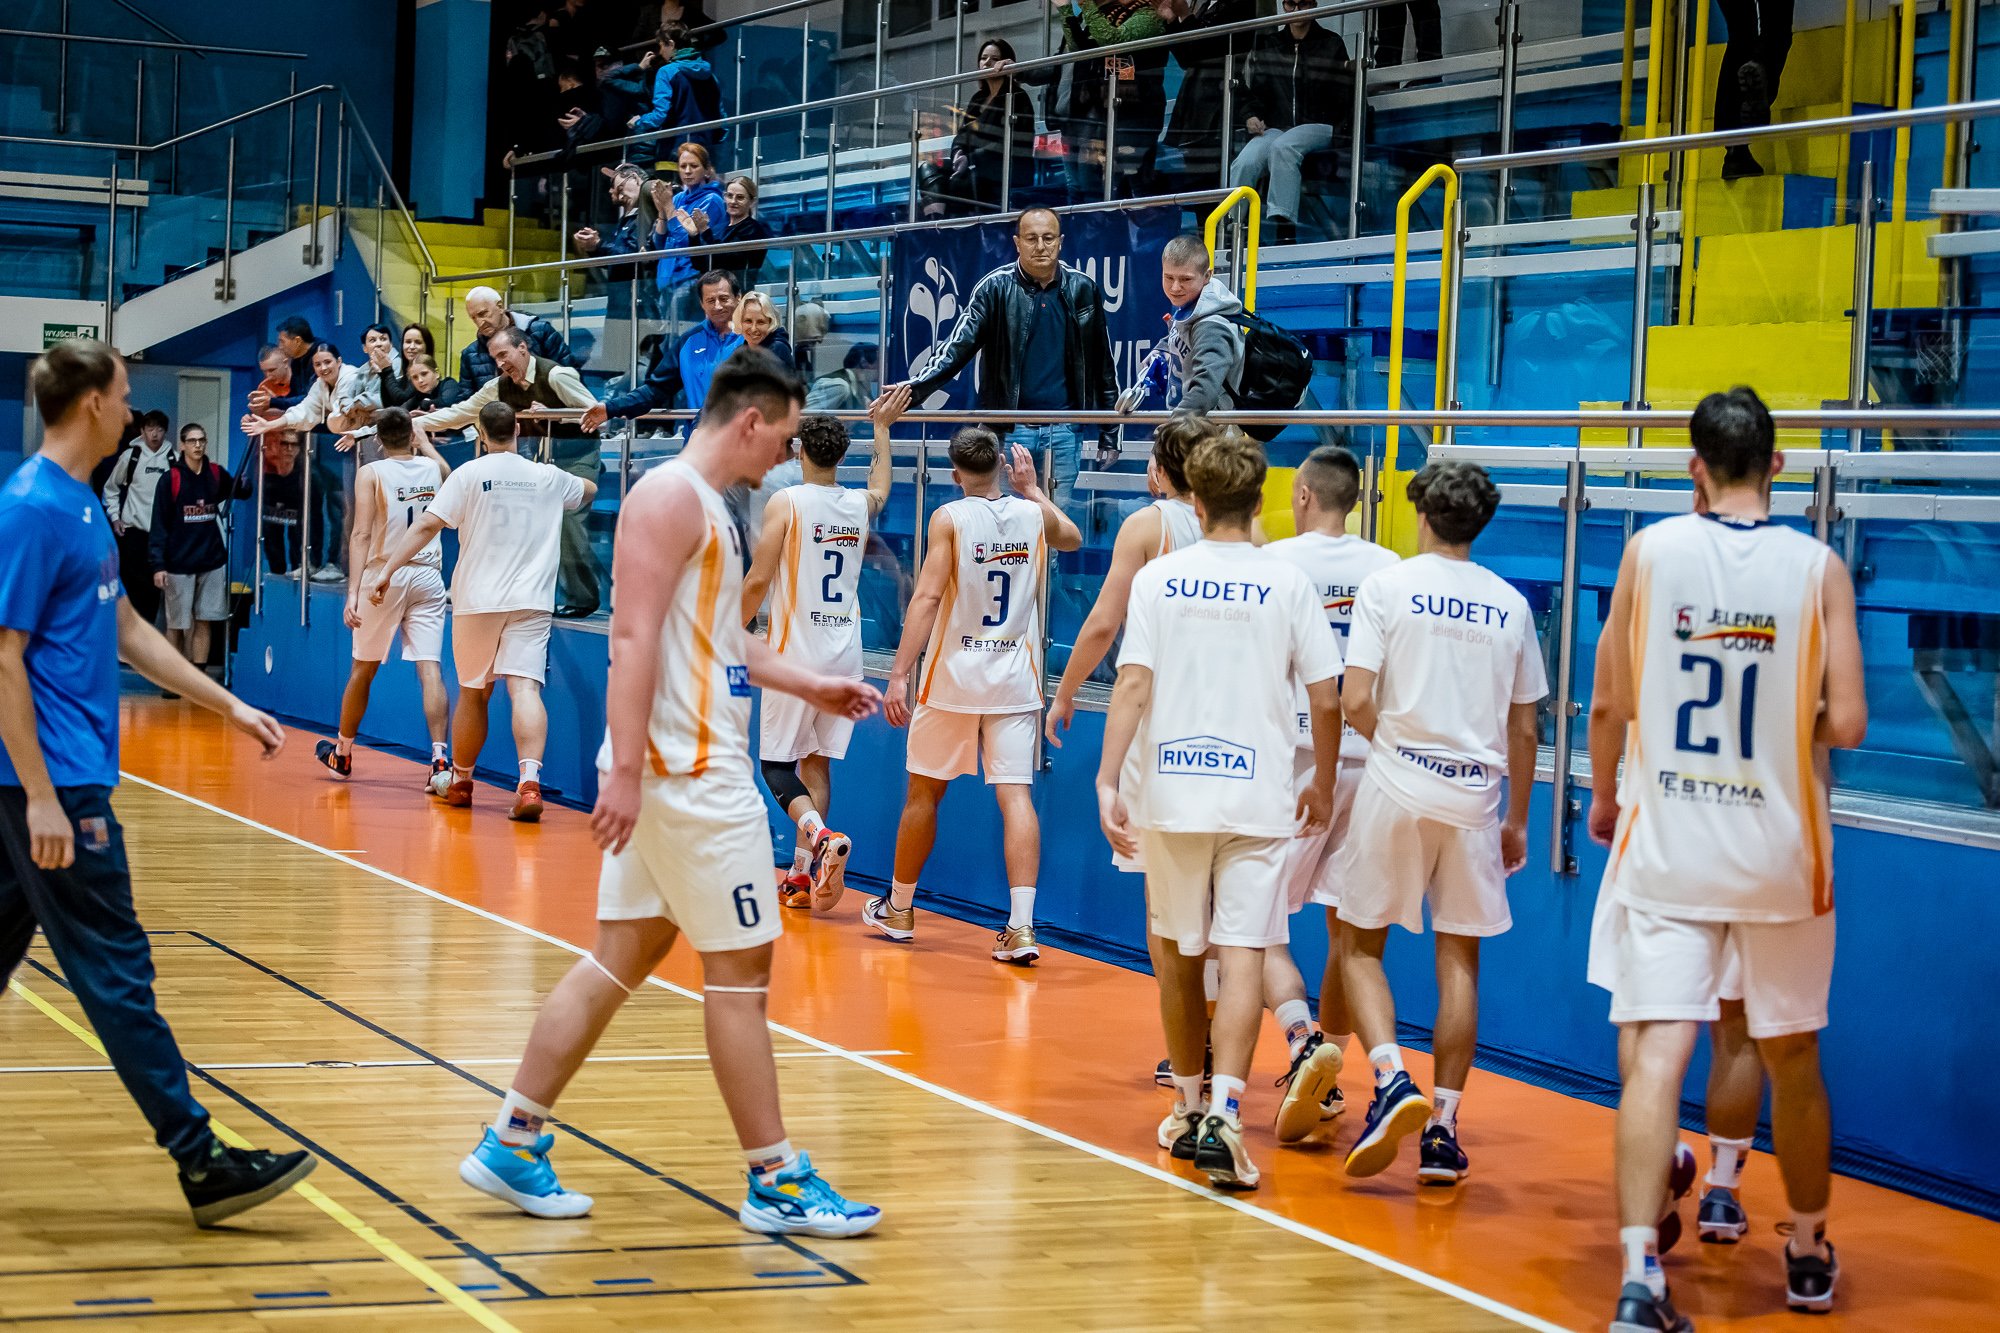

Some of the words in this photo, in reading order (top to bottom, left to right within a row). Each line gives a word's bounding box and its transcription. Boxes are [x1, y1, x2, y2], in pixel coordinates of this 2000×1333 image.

[44, 329, 77, 338] WYJŚCIE
[408, 485, 435, 493] JELENIA
[827, 524, 860, 535] JELENIA
[990, 541, 1029, 552] JELENIA
[822, 550, 844, 603] 2
[982, 570, 1011, 627] 3
[1165, 578, 1271, 604] SUDETY
[811, 611, 853, 624] ESTYMA
[1180, 604, 1220, 620] Jelenia
[1223, 607, 1251, 623] Góra
[1411, 594, 1508, 629] SUDETY
[1707, 608, 1776, 629] JELENIA
[961, 635, 1018, 648] ESTYMA
[1430, 622, 1463, 641] Jelenia
[1466, 629, 1494, 646] Góra
[1674, 652, 1759, 761] 21
[1163, 750, 1248, 771] RIVISTA
[1658, 770, 1765, 802] ESTYMA
[731, 882, 760, 927] 6
